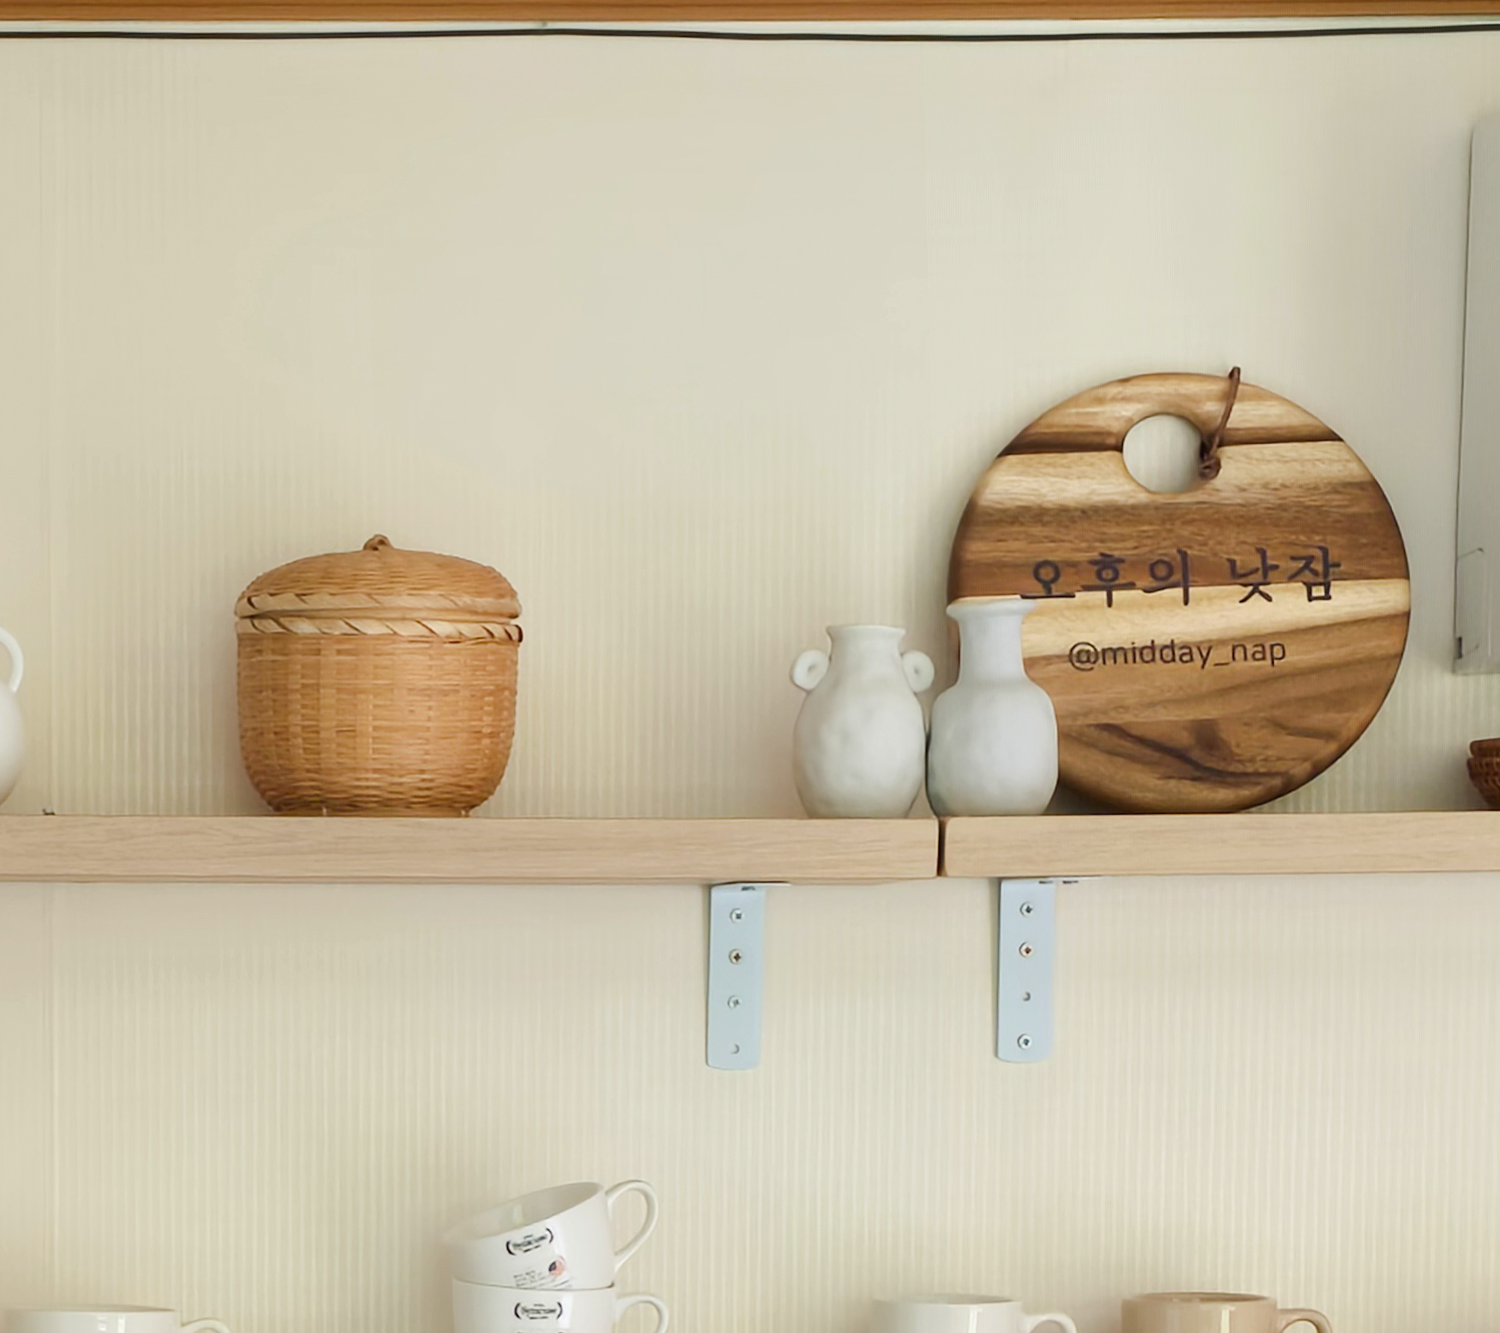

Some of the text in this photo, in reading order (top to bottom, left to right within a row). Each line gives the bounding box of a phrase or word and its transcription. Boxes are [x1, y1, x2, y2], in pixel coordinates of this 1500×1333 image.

[1019, 545, 1342, 606] 오후의 낮잠
[1068, 639, 1287, 671] @midday_nap
